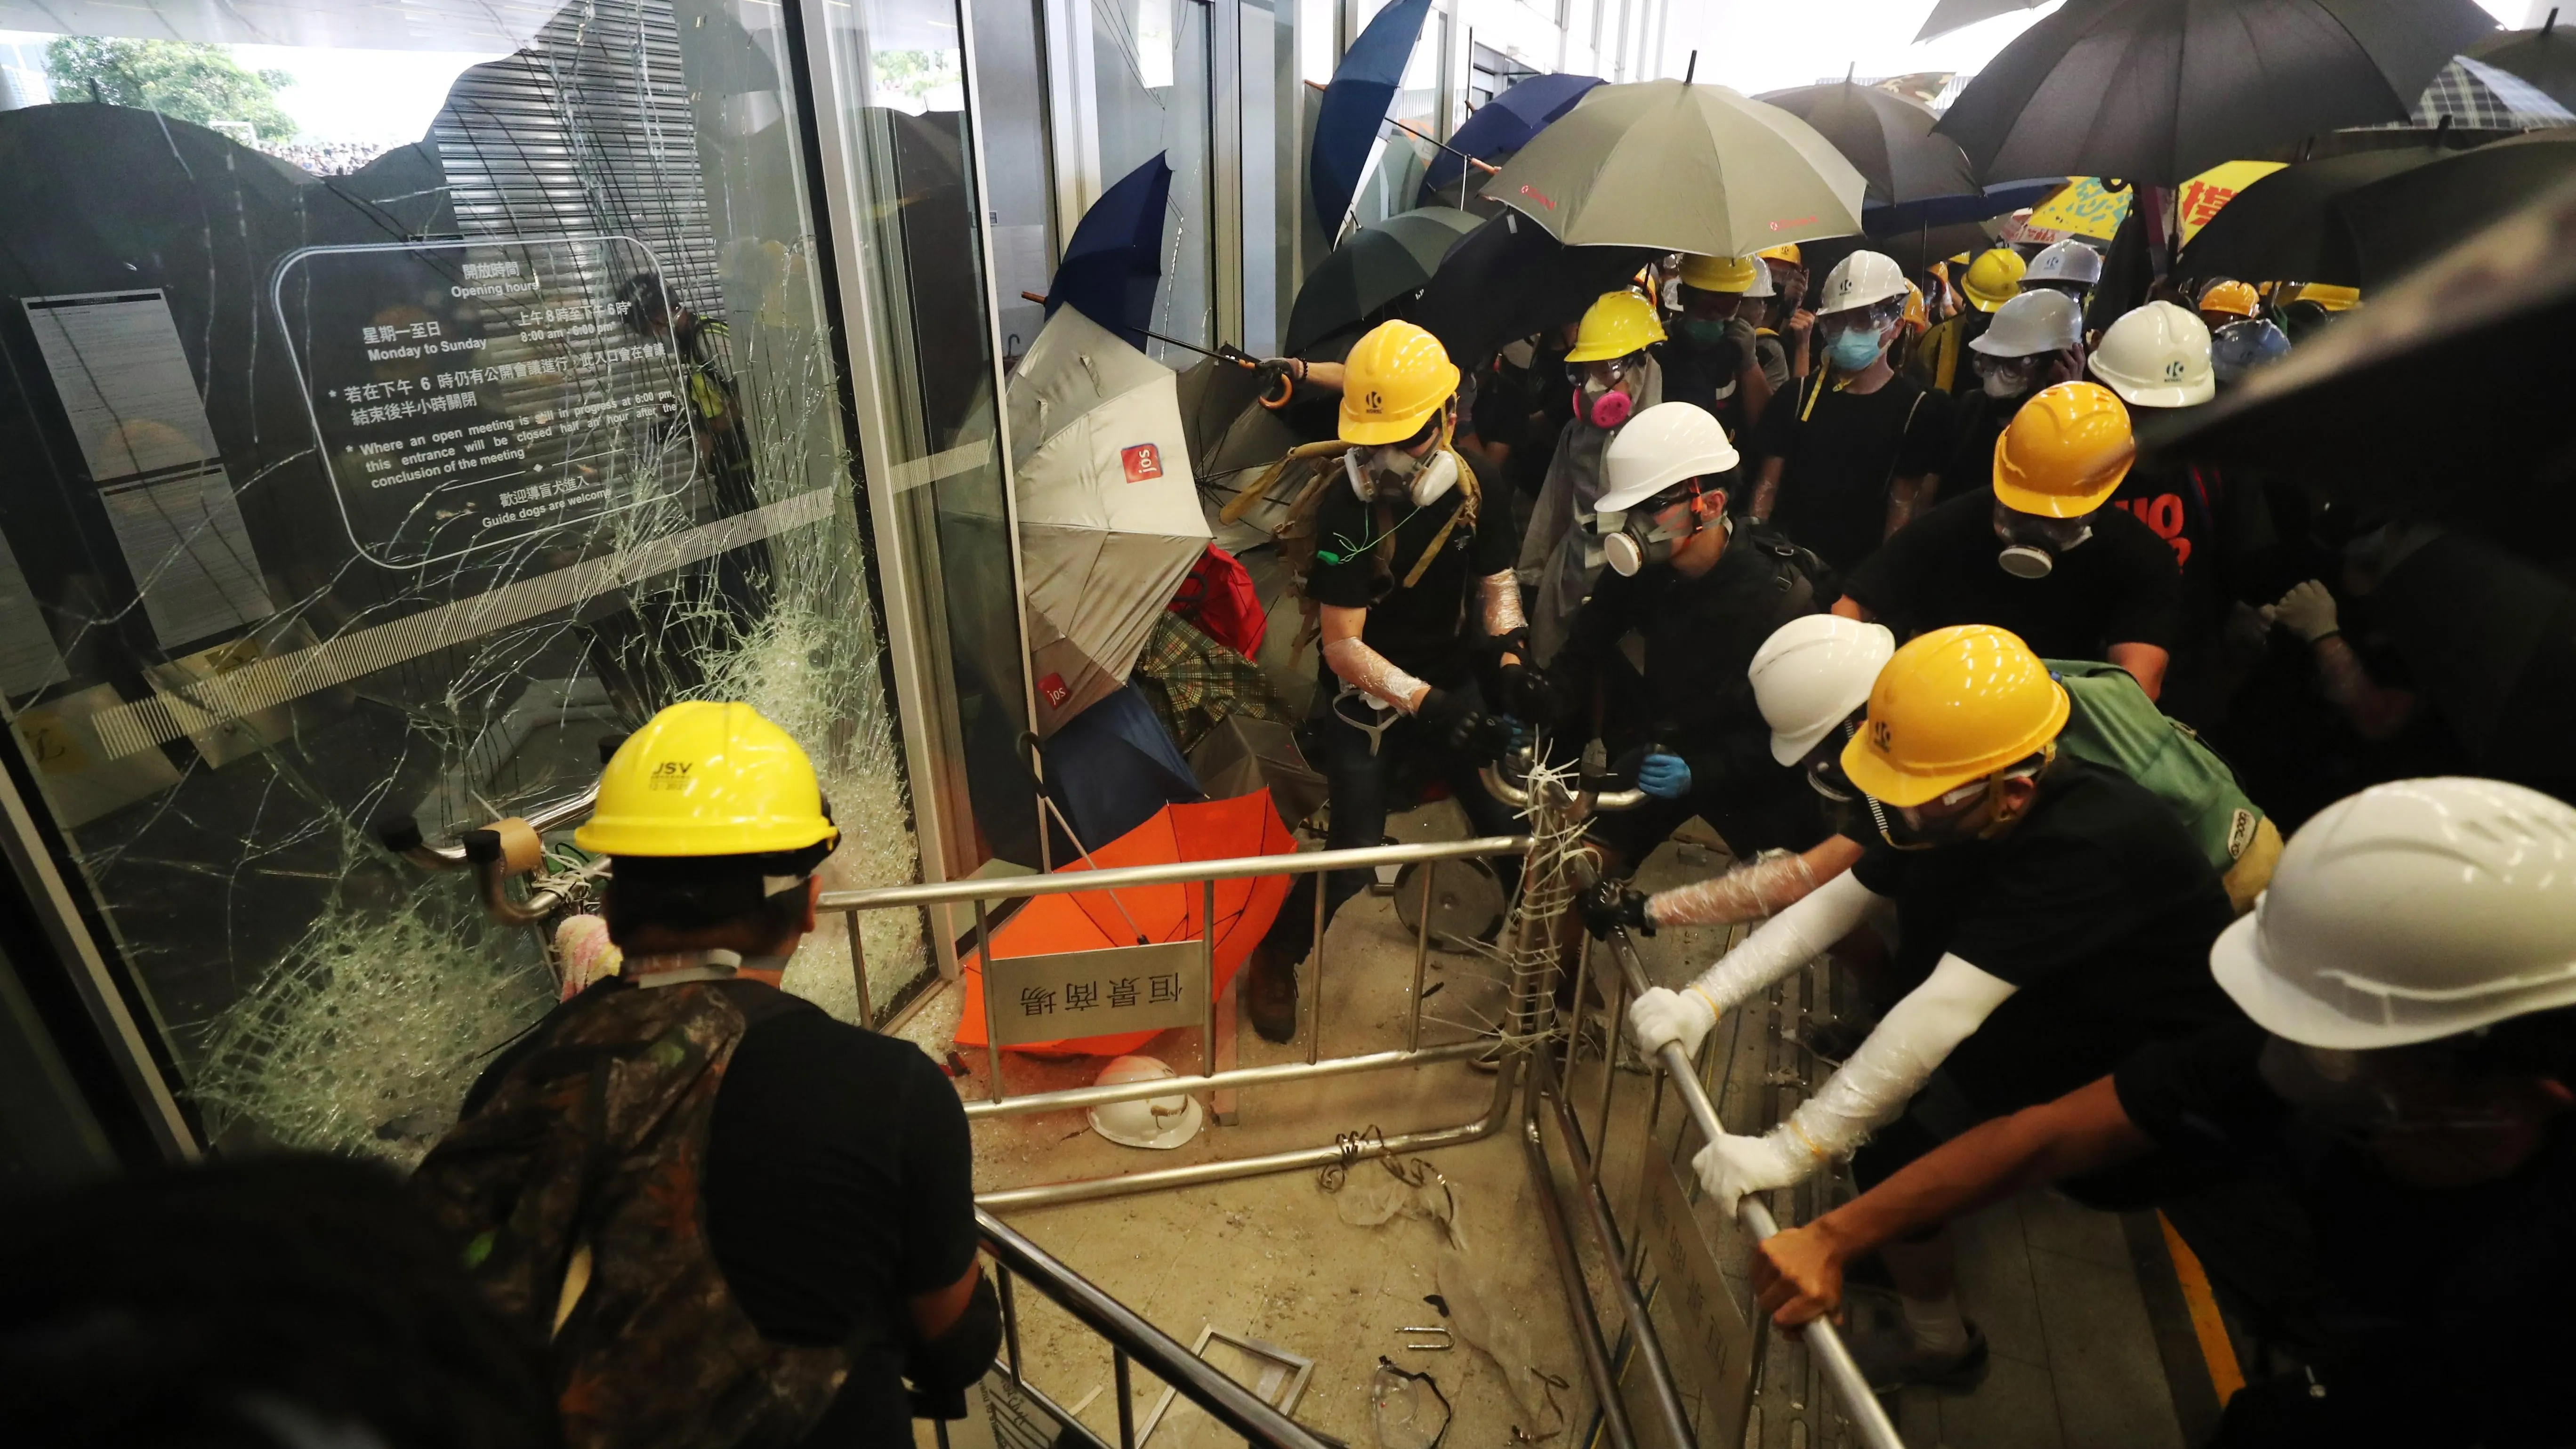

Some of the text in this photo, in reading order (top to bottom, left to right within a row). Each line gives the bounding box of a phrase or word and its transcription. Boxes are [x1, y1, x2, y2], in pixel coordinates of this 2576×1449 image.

[462, 261, 520, 280] 開放時間
[451, 281, 539, 299] Opening hours
[362, 321, 441, 344] 星期一至日
[520, 330, 545, 343] 8:00
[547, 329, 564, 339] am
[572, 324, 593, 336] 6:00
[367, 338, 487, 362] Monday to Sunday
[344, 378, 413, 404] 若在下午
[420, 377, 431, 391] 6
[350, 391, 477, 426] 結束後半小時關閉
[359, 440, 403, 456] Where
[410, 435, 426, 447] an
[432, 428, 463, 443] open
[468, 418, 515, 436] meeting
[519, 416, 530, 426] is
[534, 411, 554, 424] still
[559, 408, 569, 419] in
[574, 400, 618, 418] progress
[622, 396, 631, 407] at
[635, 392, 654, 404] 6:00
[366, 403, 676, 473] this entrance will be closed half an hour after the
[371, 448, 525, 489] conclusion of the meeting
[1138, 449, 1157, 474] jos
[498, 475, 589, 508] 歡迎導盲犬進入
[482, 488, 612, 528] Guide dogs are welcome
[1046, 688, 1066, 705] jos
[653, 762, 693, 774] JSV
[1020, 972, 1183, 1016] 恒景商場
